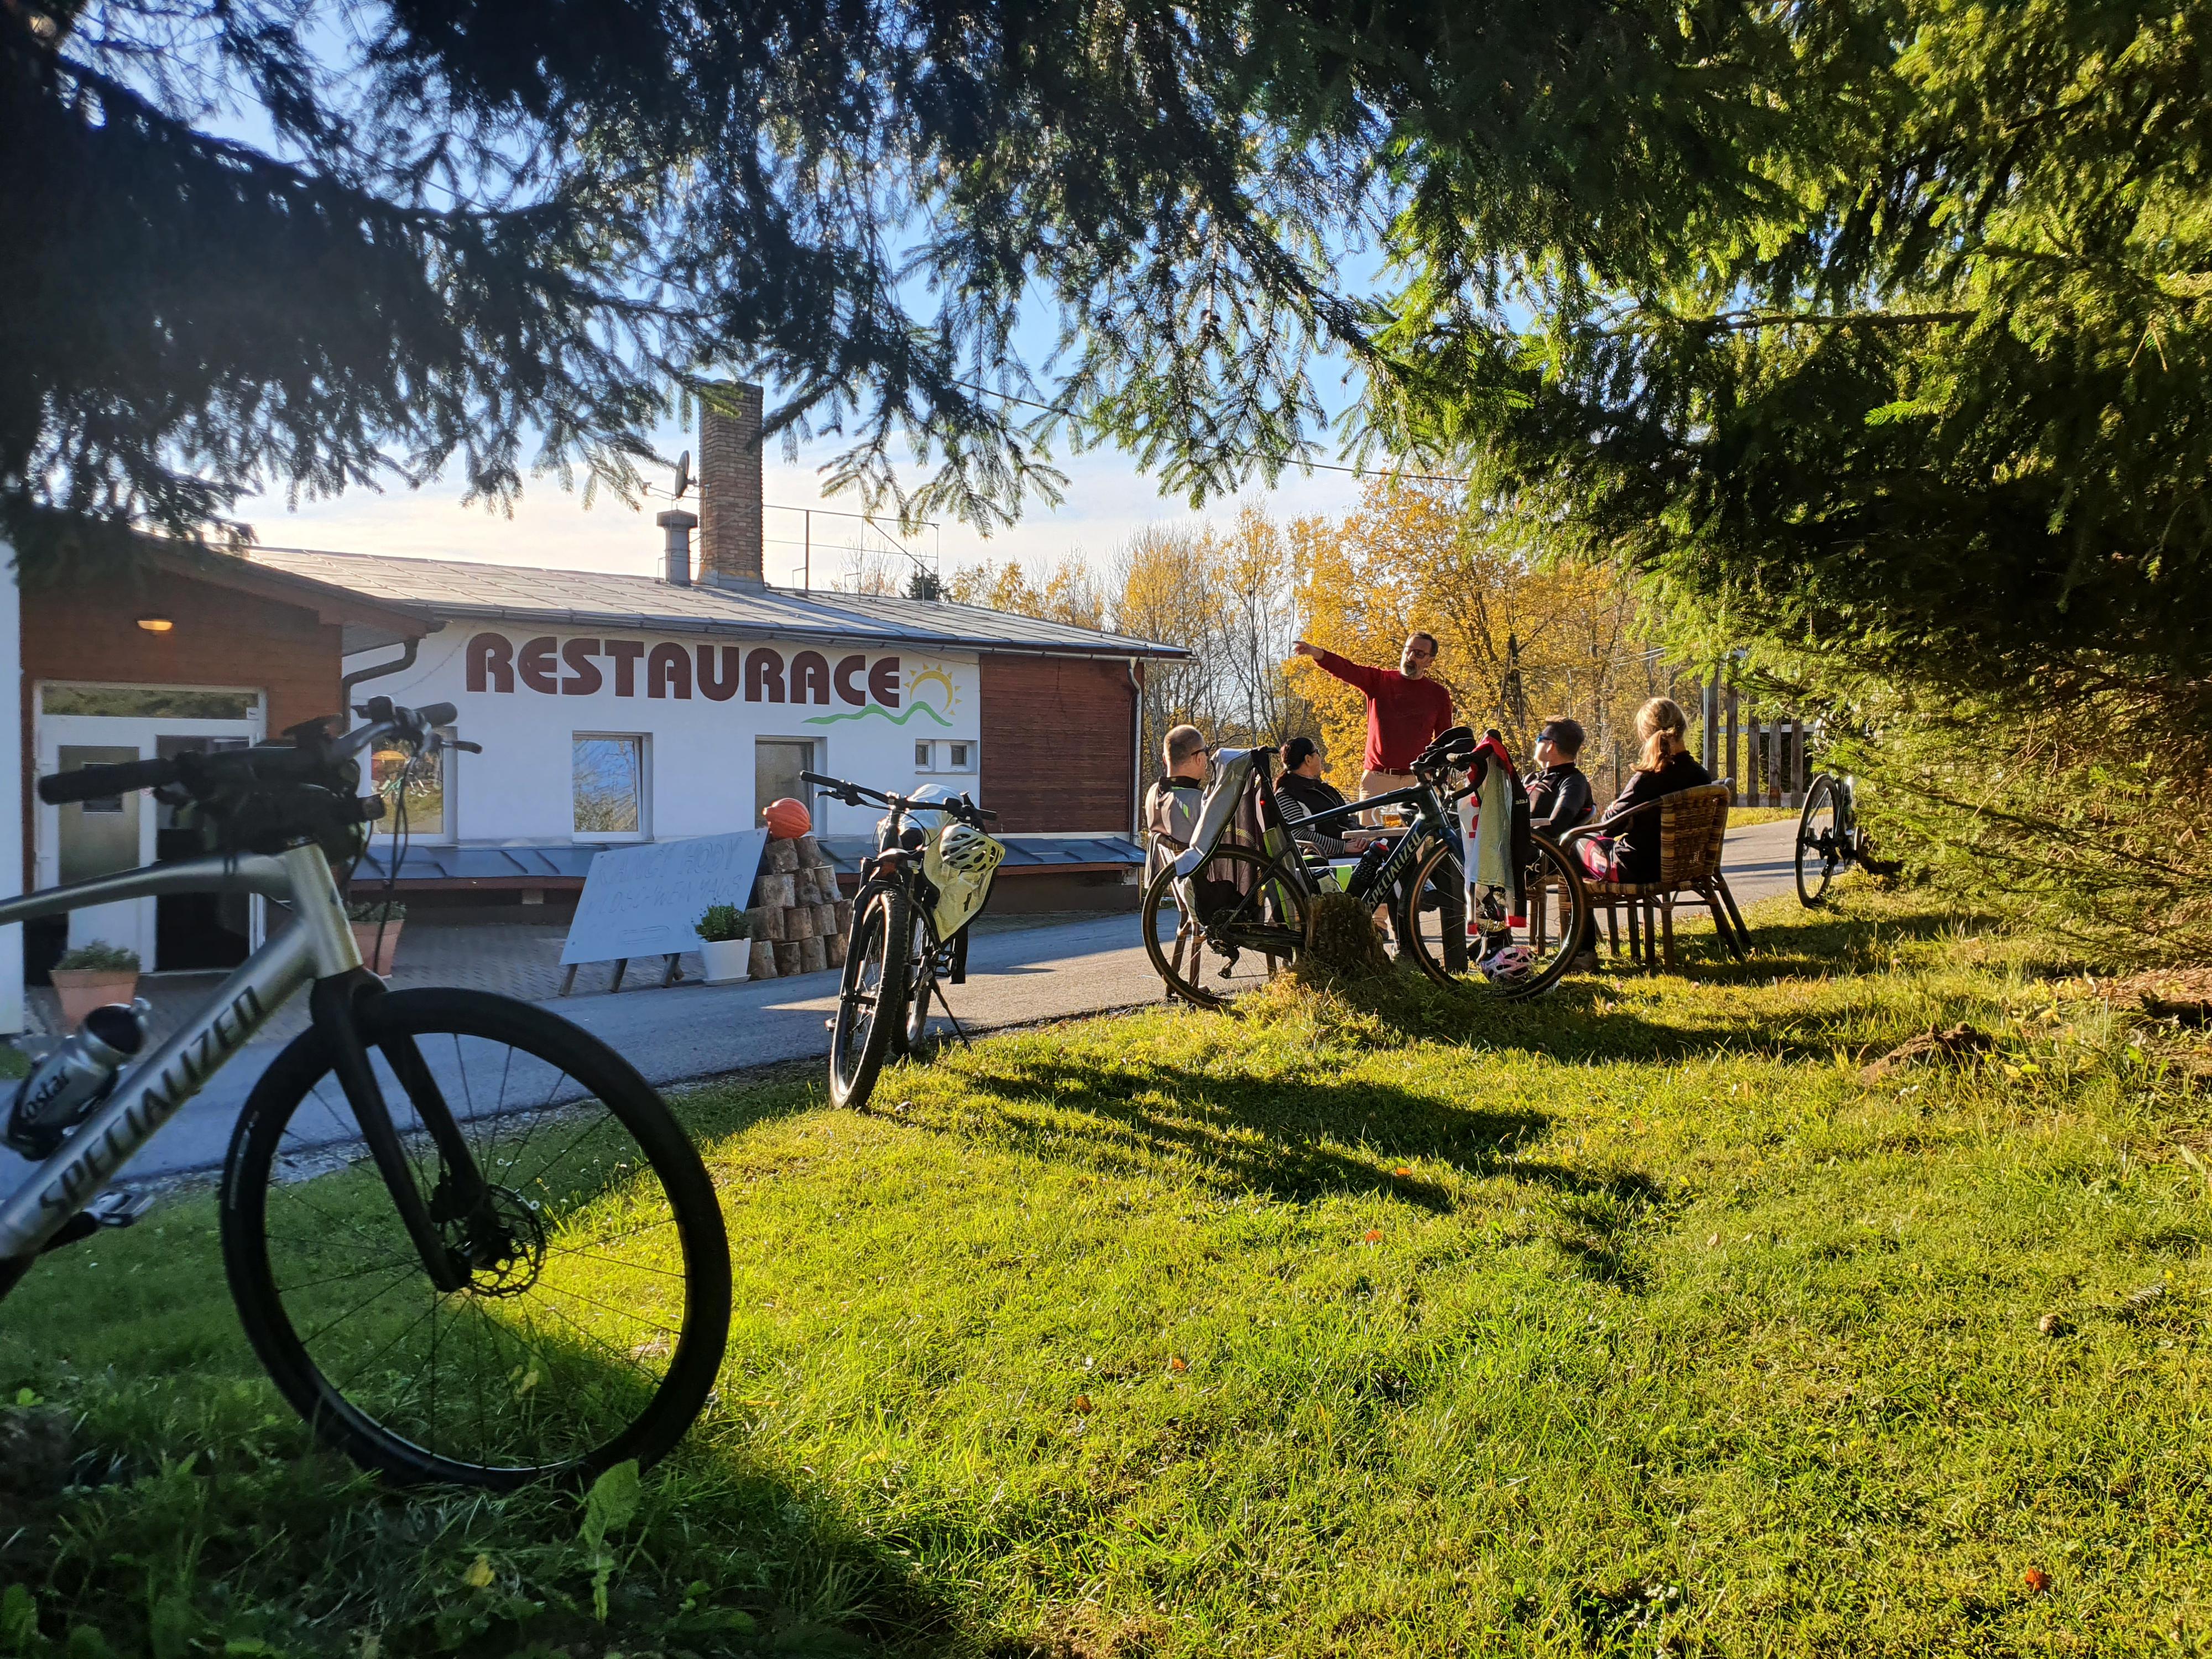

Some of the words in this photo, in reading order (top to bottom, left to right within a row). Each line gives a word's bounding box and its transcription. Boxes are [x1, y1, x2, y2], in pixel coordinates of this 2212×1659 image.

[466, 633, 900, 708] RESTAURACE
[1365, 831, 1422, 910] SPECIALIZED
[39, 985, 264, 1213] SPECIALIZED
